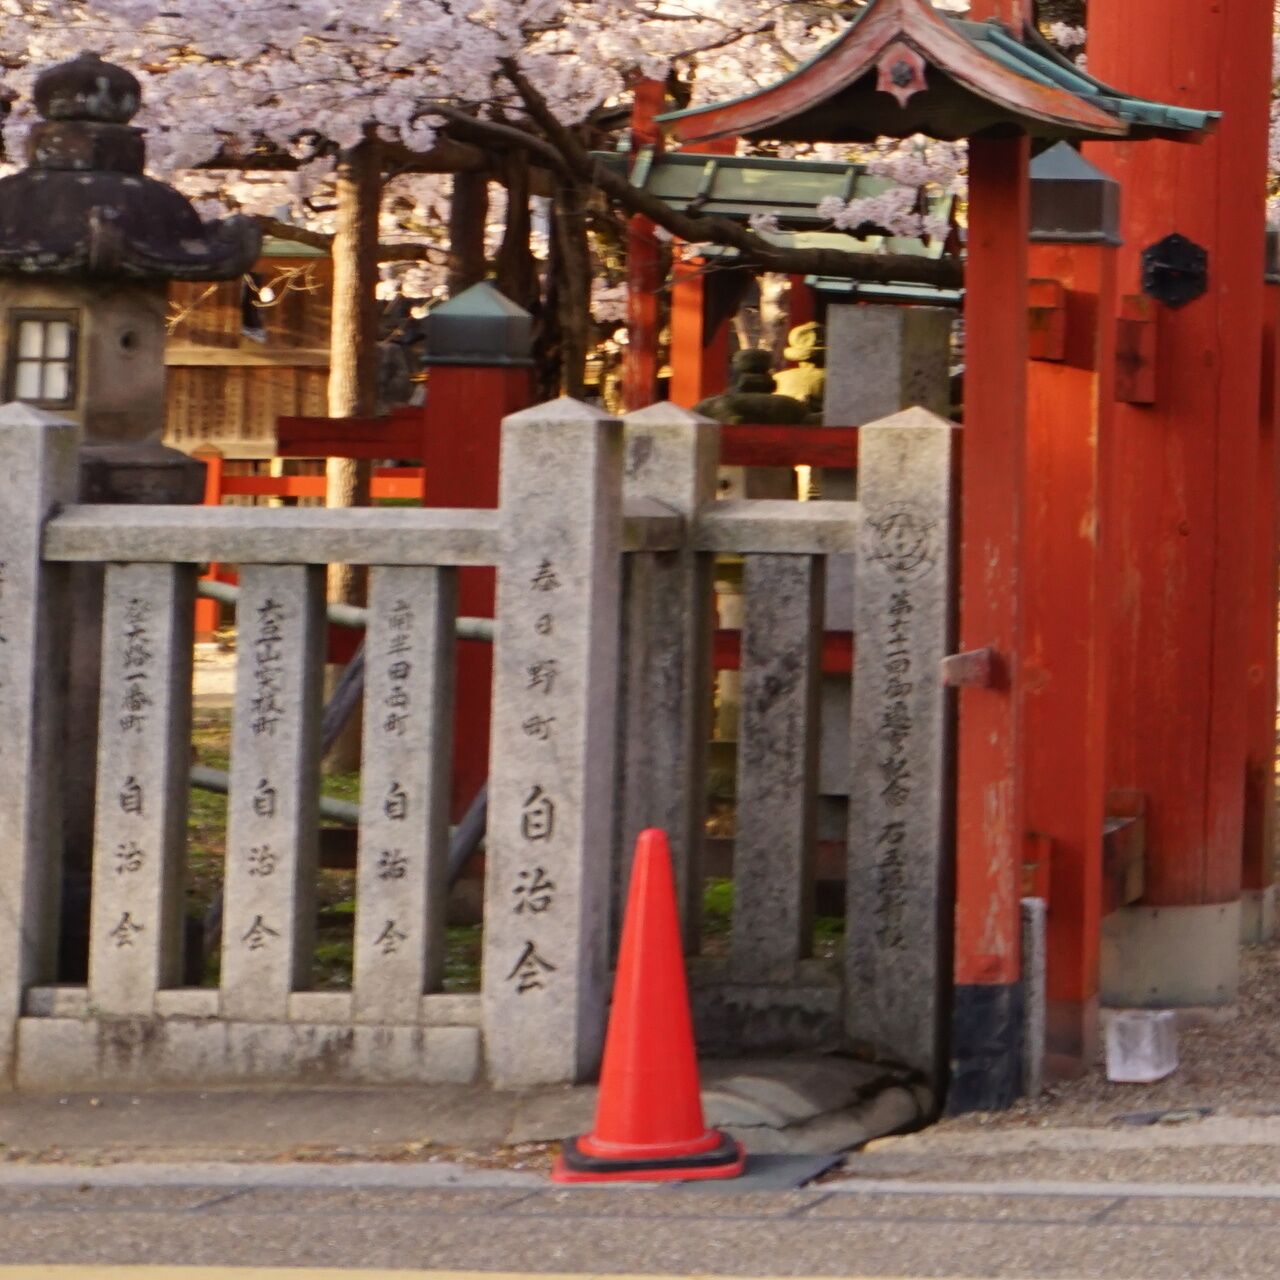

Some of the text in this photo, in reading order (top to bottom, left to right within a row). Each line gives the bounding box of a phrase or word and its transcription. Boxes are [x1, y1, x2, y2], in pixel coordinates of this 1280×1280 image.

[505, 557, 562, 996] 春日野町自治会
